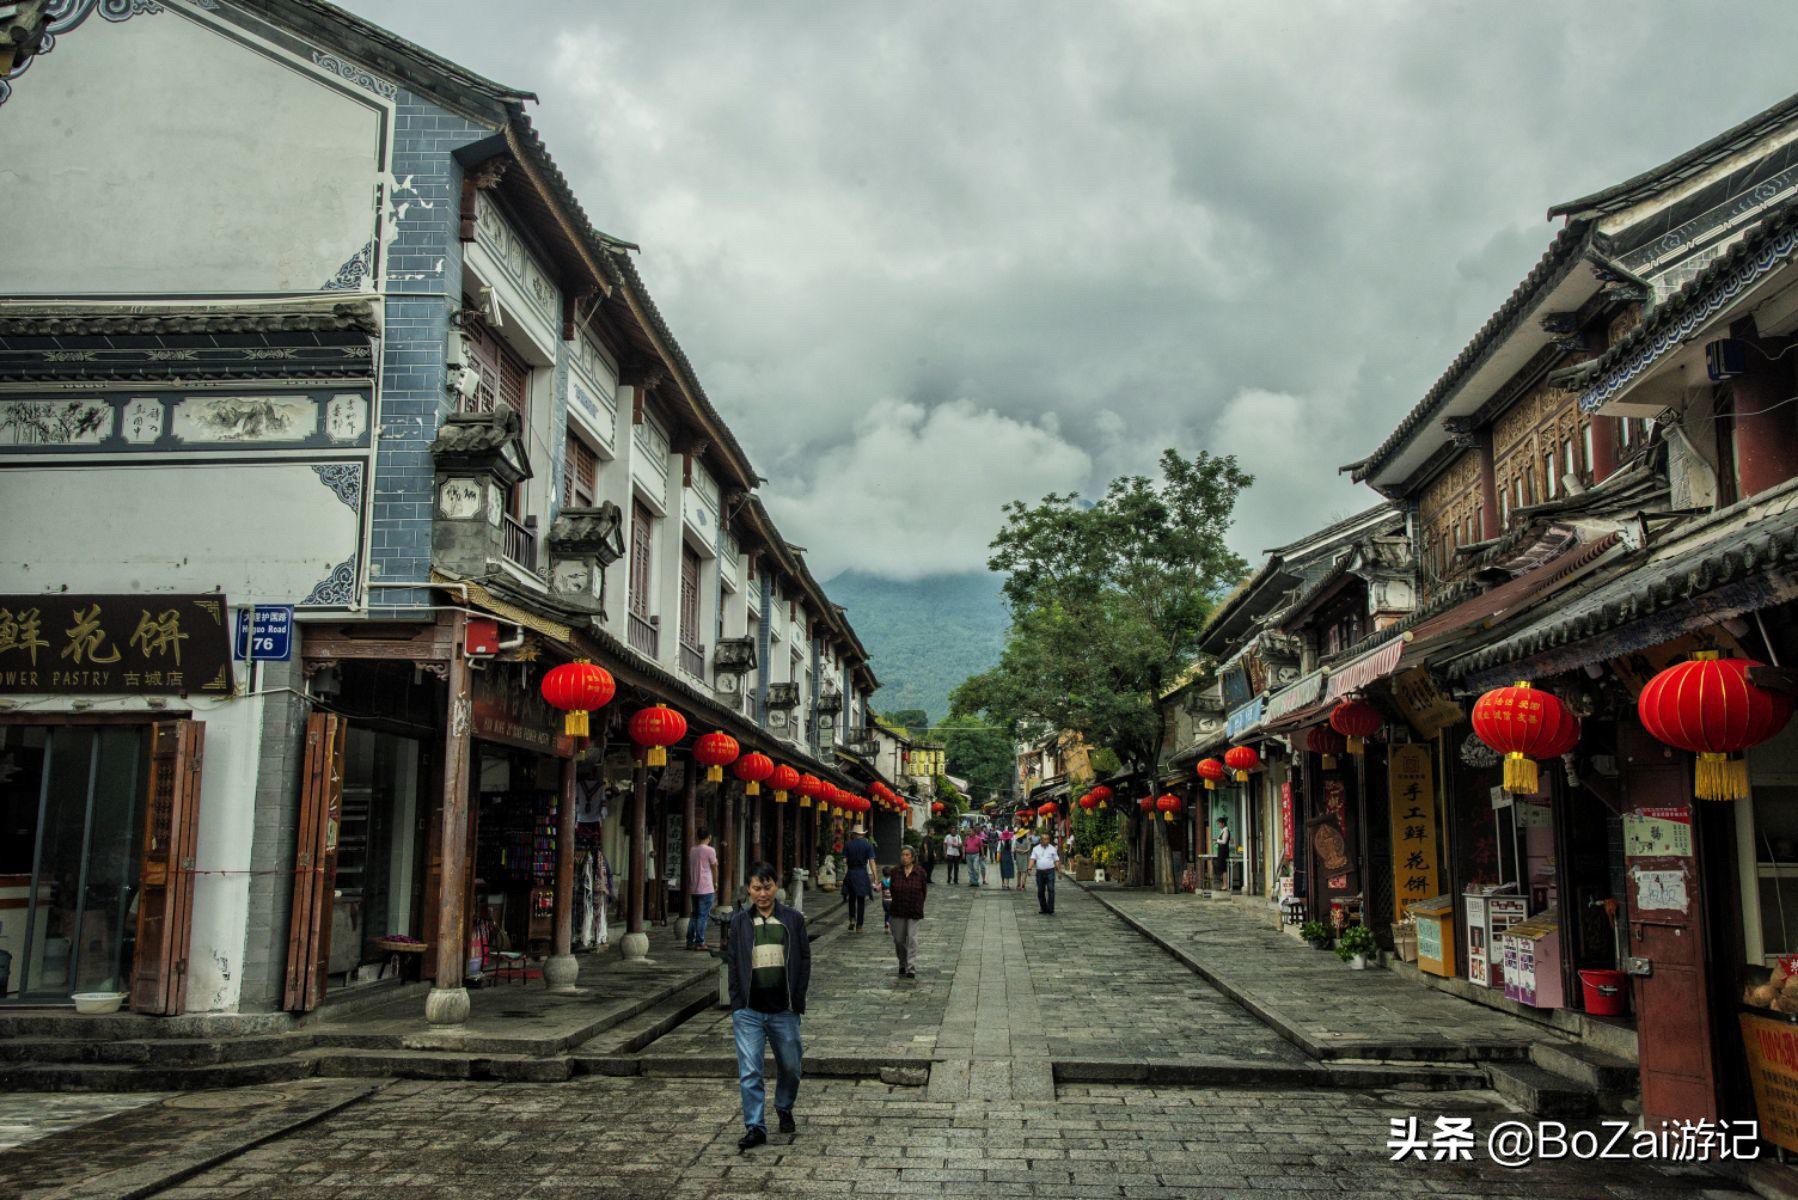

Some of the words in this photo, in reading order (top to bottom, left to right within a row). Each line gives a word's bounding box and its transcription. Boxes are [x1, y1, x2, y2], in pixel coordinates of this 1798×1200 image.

[0, 602, 190, 667] 鲜花饼
[242, 624, 265, 635] Hguo
[268, 624, 287, 634] Road
[253, 637, 274, 650] 76
[52, 671, 110, 687] PASTRY
[123, 671, 185, 687] 古城店
[1402, 783, 1430, 896] 手工鲜花饼
